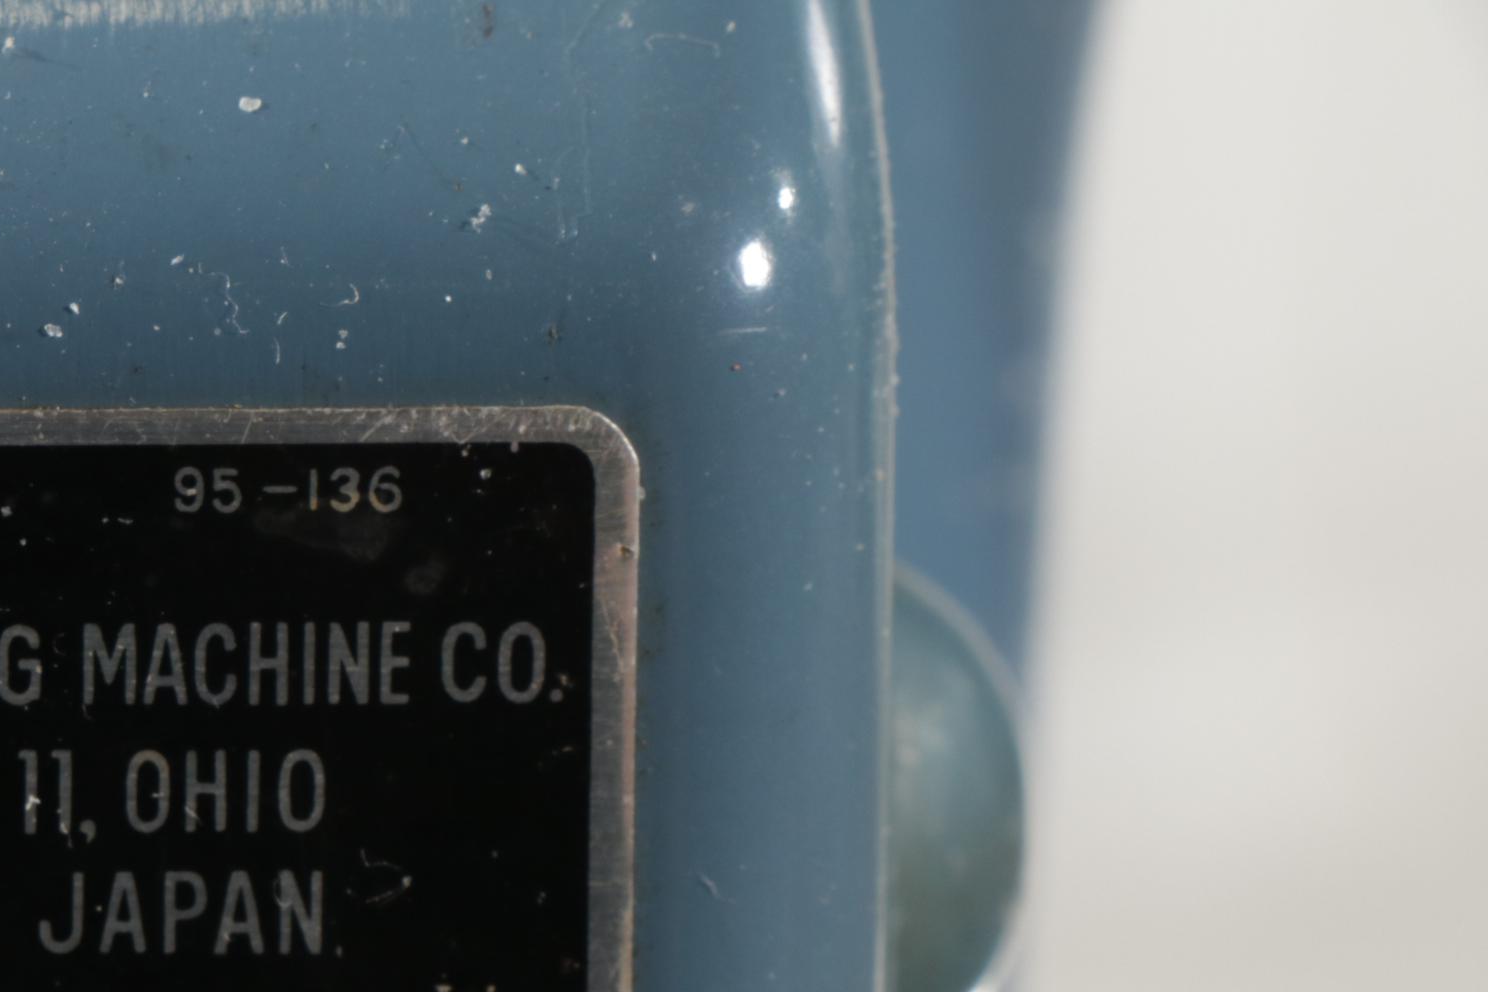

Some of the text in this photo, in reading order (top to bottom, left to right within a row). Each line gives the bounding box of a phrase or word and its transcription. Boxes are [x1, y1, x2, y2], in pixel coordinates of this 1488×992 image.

[81, 621, 412, 706] MACHINE
[439, 620, 564, 703] CO.
[124, 748, 327, 834] OHIO
[38, 869, 325, 956] JAPAN
